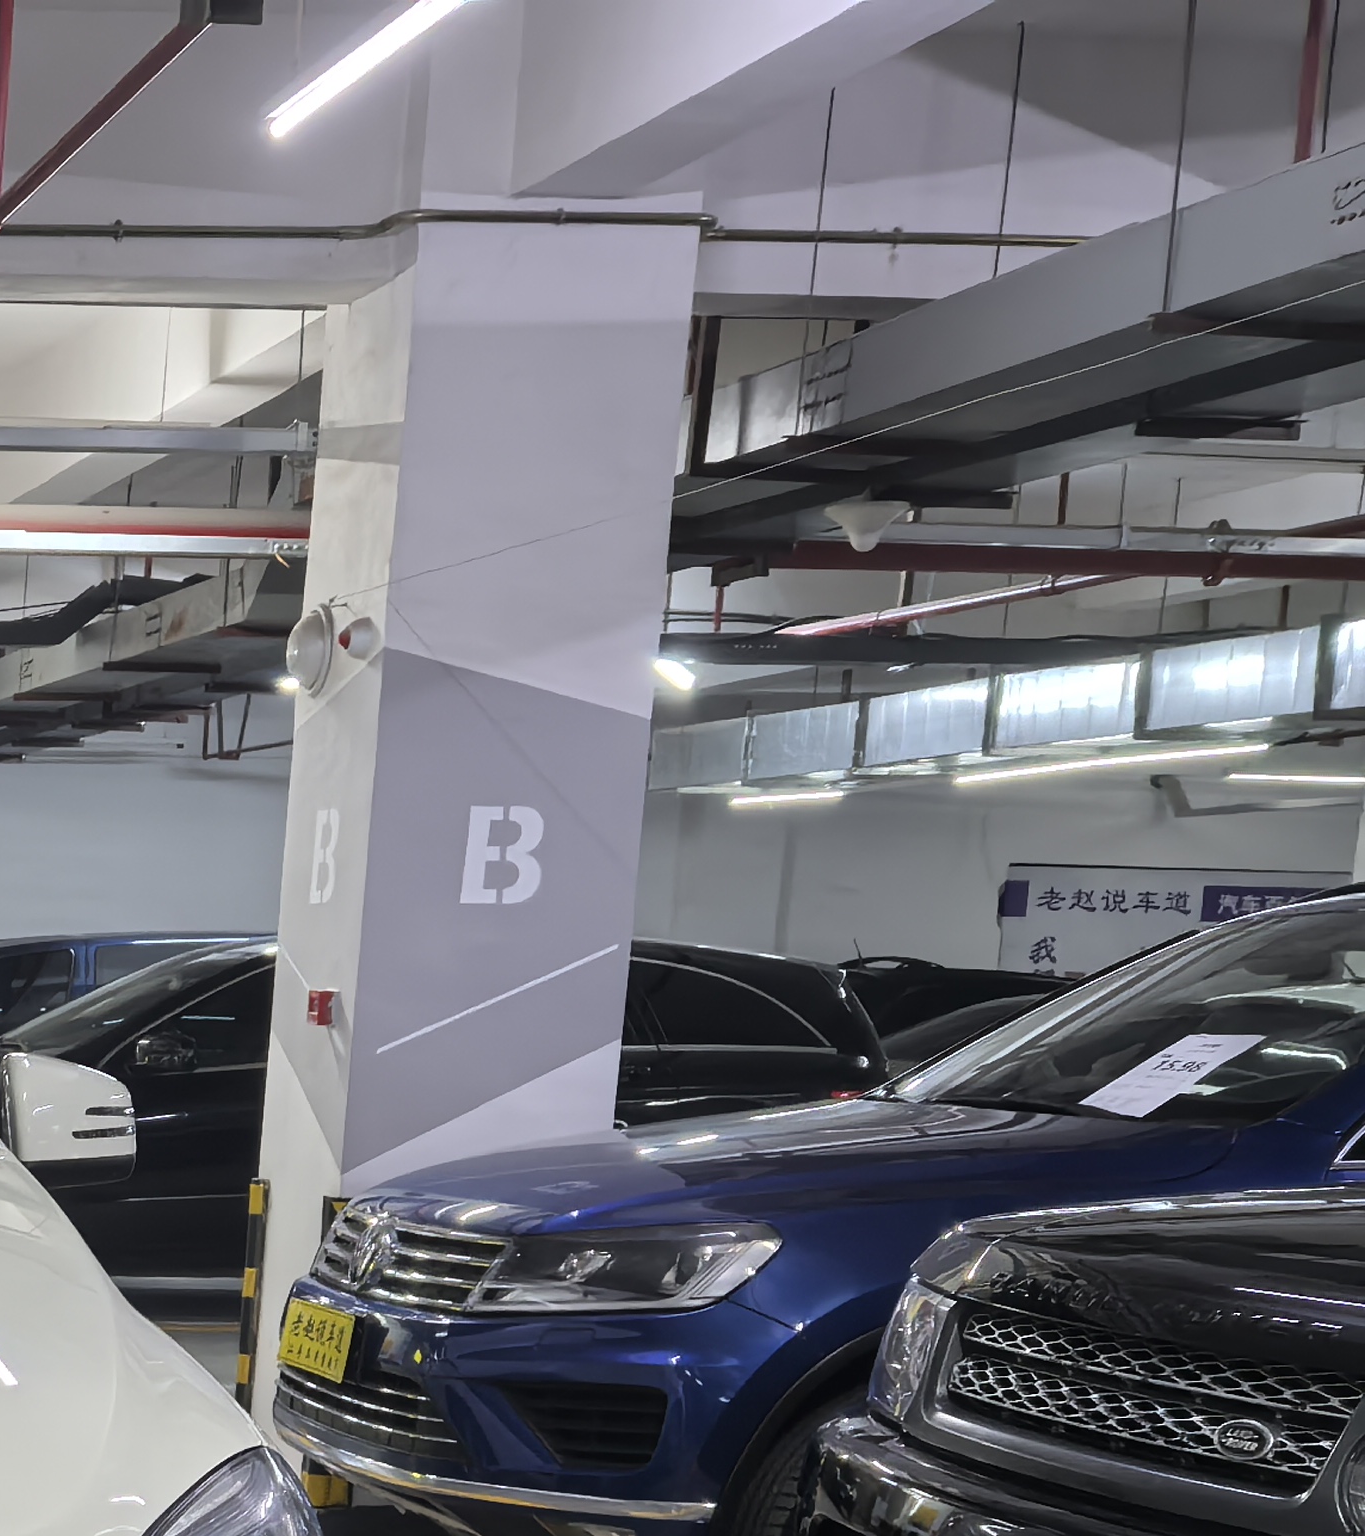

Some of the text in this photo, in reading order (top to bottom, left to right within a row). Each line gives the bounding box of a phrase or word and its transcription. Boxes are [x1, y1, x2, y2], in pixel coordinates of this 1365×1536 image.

[309, 808, 340, 904] B
[460, 805, 545, 905] B
[1036, 886, 1192, 916] 老赵说车道
[1029, 936, 1057, 964] 我
